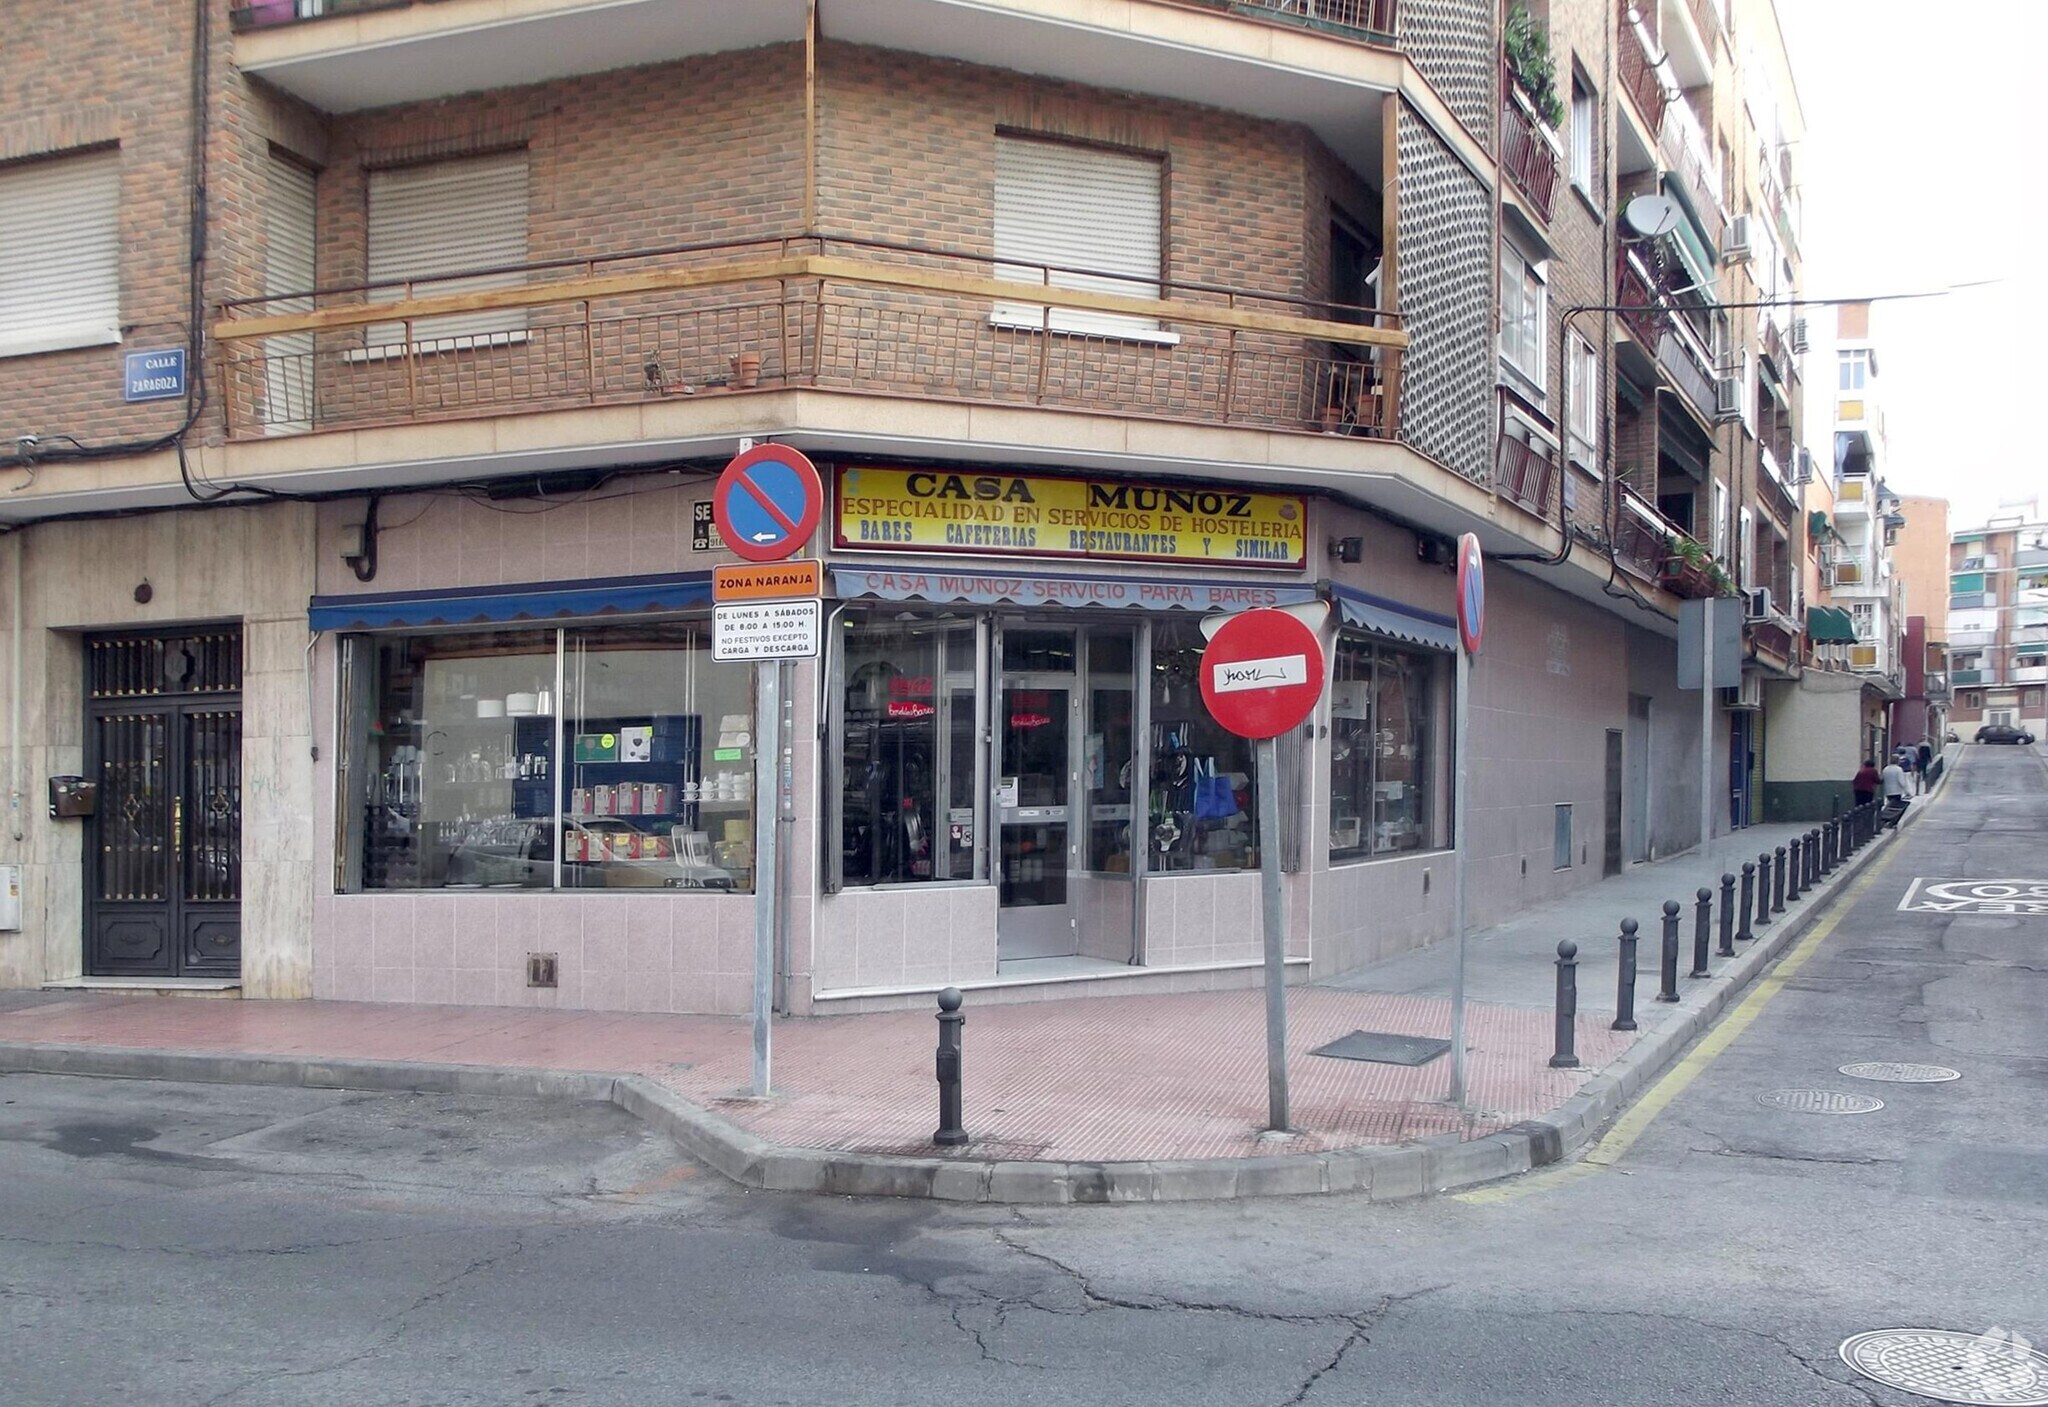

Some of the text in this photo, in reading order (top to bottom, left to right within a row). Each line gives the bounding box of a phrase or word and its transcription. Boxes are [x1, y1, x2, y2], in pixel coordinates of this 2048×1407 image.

[145, 357, 177, 370] CALLE
[132, 376, 178, 393] ZARAGOZA
[906, 472, 1036, 504] CASA
[843, 497, 1302, 539] ESPECIALIDAD EN SERVICIOS DE HOSTELERIA
[860, 519, 1289, 560] BARES CAFETERIAS RESTAURANTES Y SIMILAR
[720, 574, 813, 589] ZONA NARANJA
[866, 573, 930, 592] CASA
[1033, 581, 1126, 599] SERVICIO
[1140, 584, 1194, 602] PARA
[1208, 587, 1277, 605] BARES
[717, 612, 728, 620] DE
[732, 610, 760, 620] LUNES
[774, 608, 815, 617] SÁBADOS
[722, 632, 809, 645] NO FESTIVOS EXCEPTO
[721, 646, 750, 655] CARGA
[763, 644, 810, 653] DESCARGA
